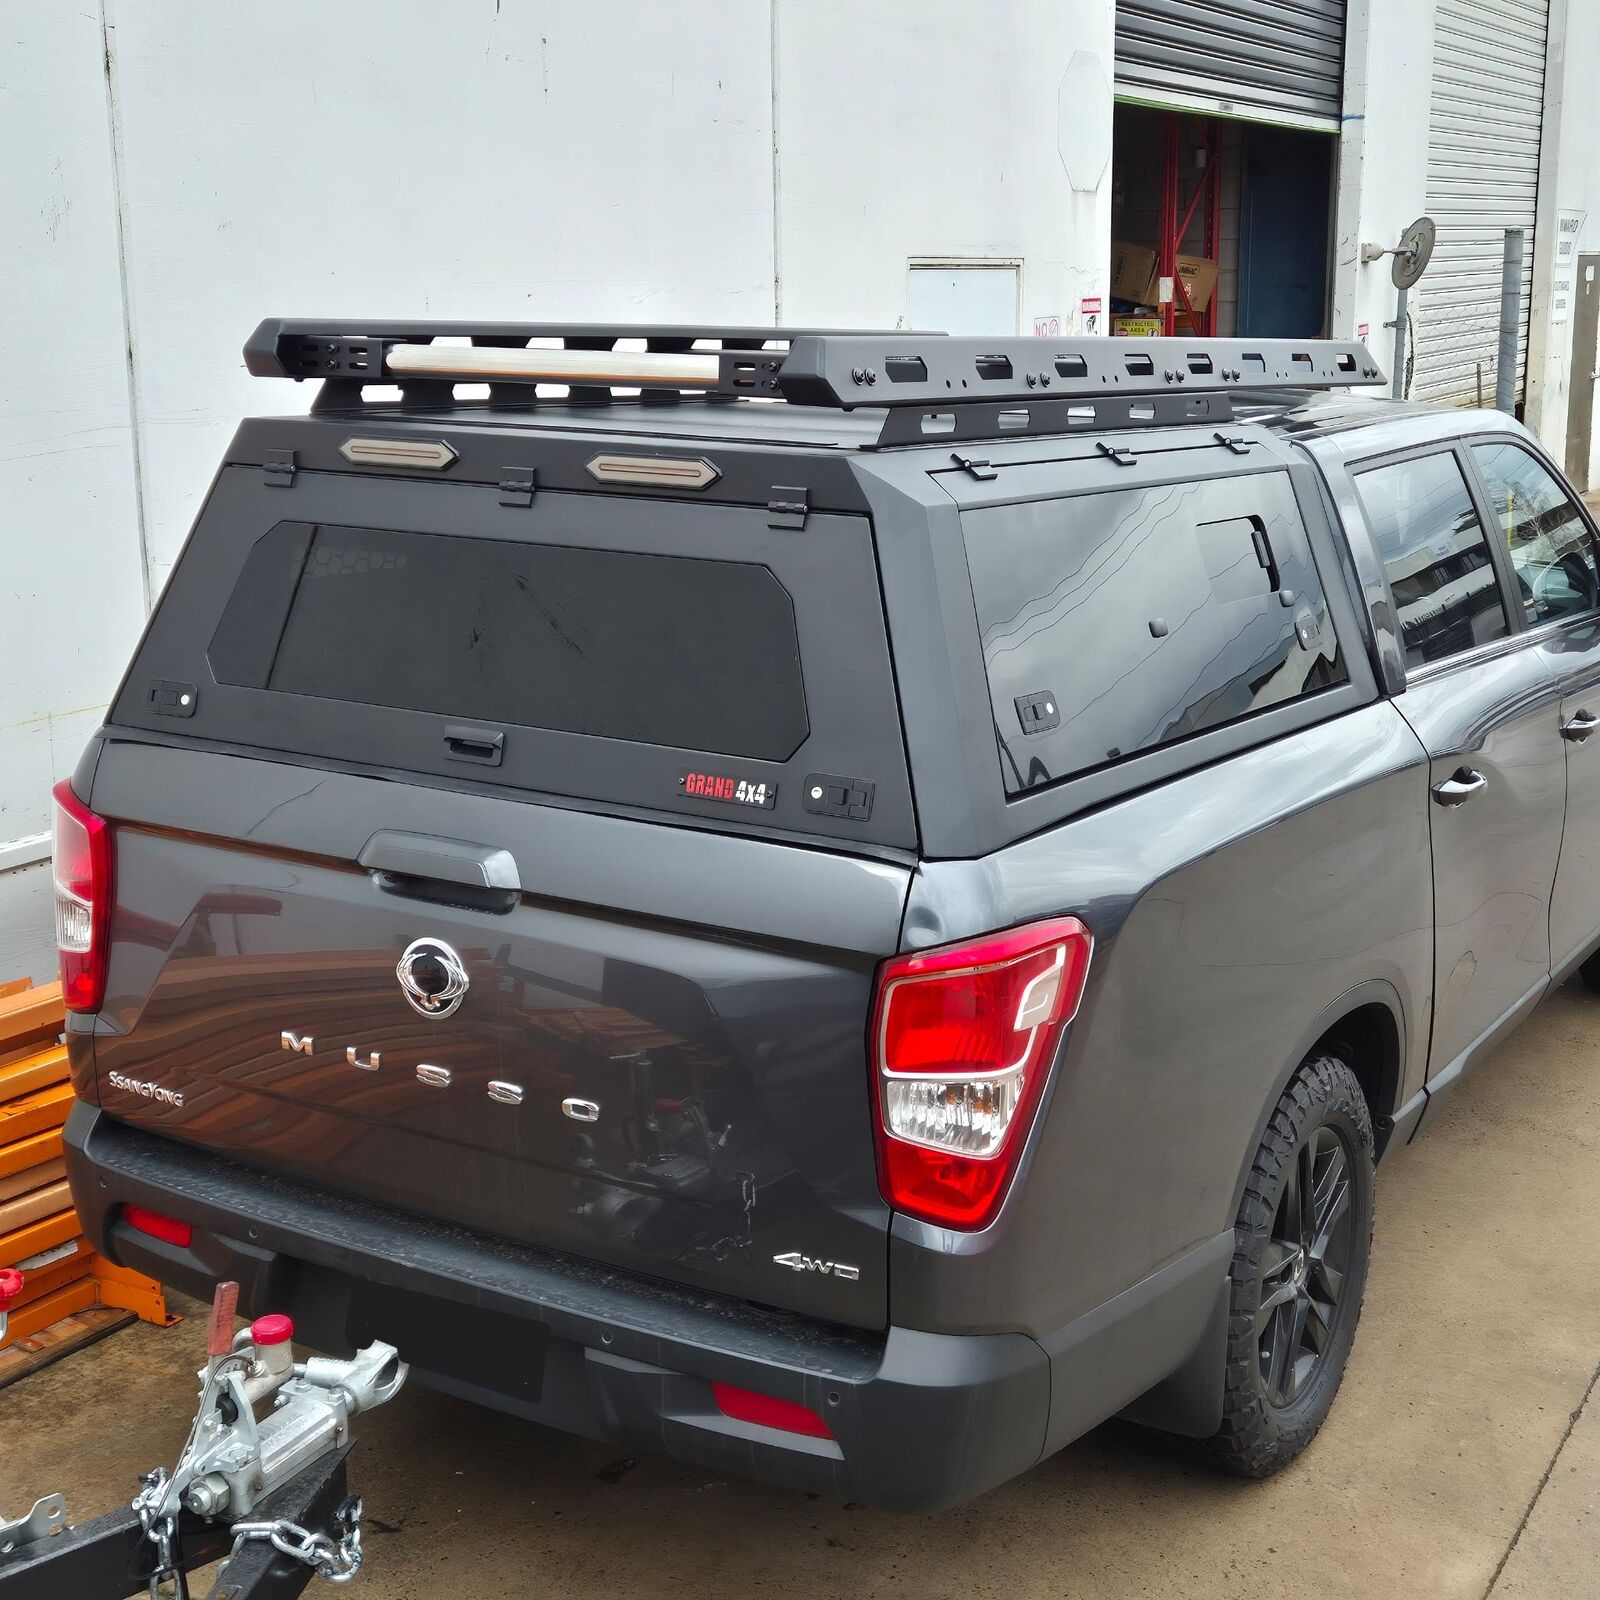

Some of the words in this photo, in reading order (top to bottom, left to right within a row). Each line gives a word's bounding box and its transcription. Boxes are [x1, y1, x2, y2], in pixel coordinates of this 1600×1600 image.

[1035, 322, 1048, 337] NO
[686, 773, 735, 799] GRAND
[108, 1070, 184, 1107] SSANGYONG
[281, 1031, 600, 1123] MUSSO
[772, 1252, 860, 1281] 4WD
